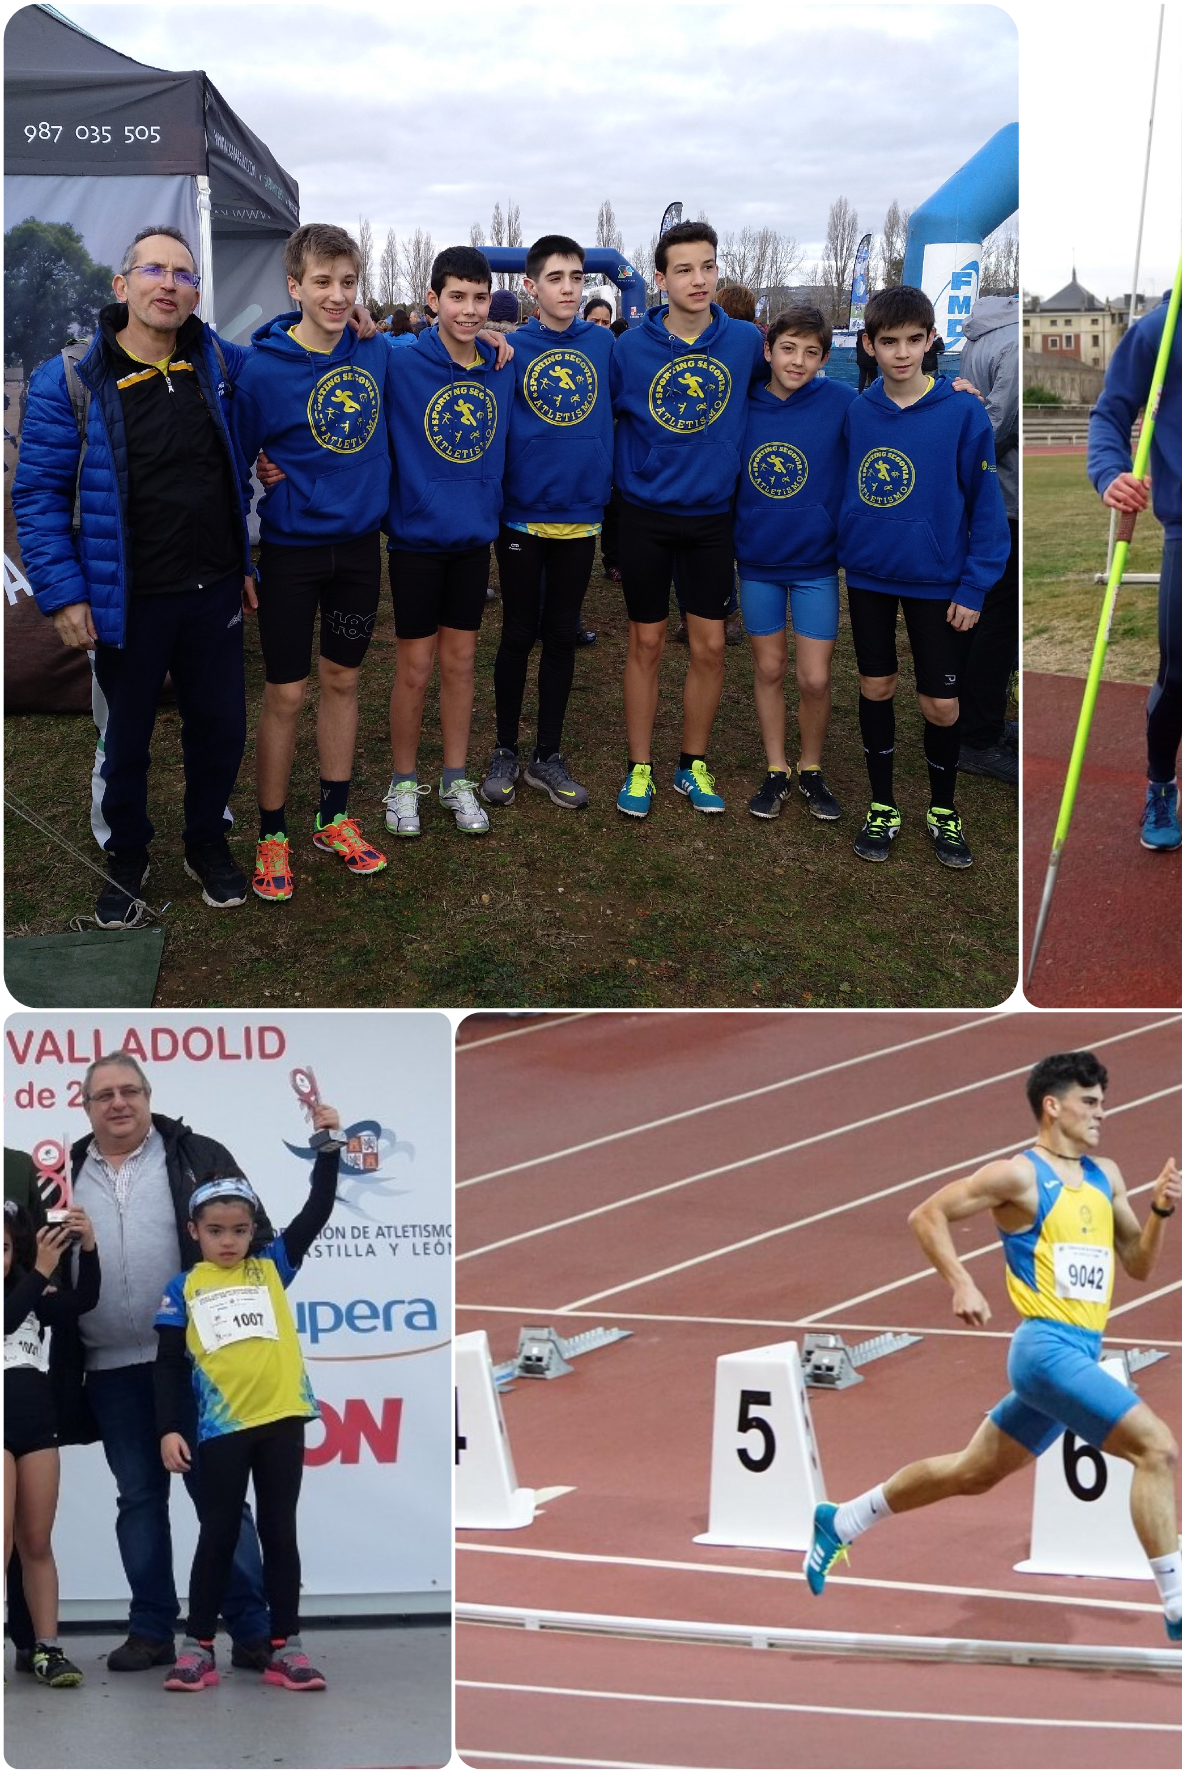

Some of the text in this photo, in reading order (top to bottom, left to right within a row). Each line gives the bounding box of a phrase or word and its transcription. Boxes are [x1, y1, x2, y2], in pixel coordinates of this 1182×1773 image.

[24, 121, 161, 144] 987 035 505
[530, 353, 592, 391] SPORTING SEGOVIA
[534, 393, 594, 421] ATLETISMO
[656, 395, 722, 424] ATLETISMO
[433, 428, 491, 458] ATLETISO
[779, 446, 803, 470] SEGOVIA
[887, 452, 909, 480] SEGOVIA
[755, 476, 804, 496] ATLETISMO
[860, 486, 908, 504] ATLETISMO
[6, 1026, 286, 1064] VALLADOLID
[15, 1081, 56, 1109] de
[350, 1225, 370, 1240] DE
[388, 1243, 399, 1257] Y
[412, 1239, 451, 1256] LEÓ
[1068, 1264, 1104, 1290] 9042
[233, 1312, 263, 1328] 1007
[737, 1389, 776, 1473] 5
[1063, 1427, 1107, 1502] 6
